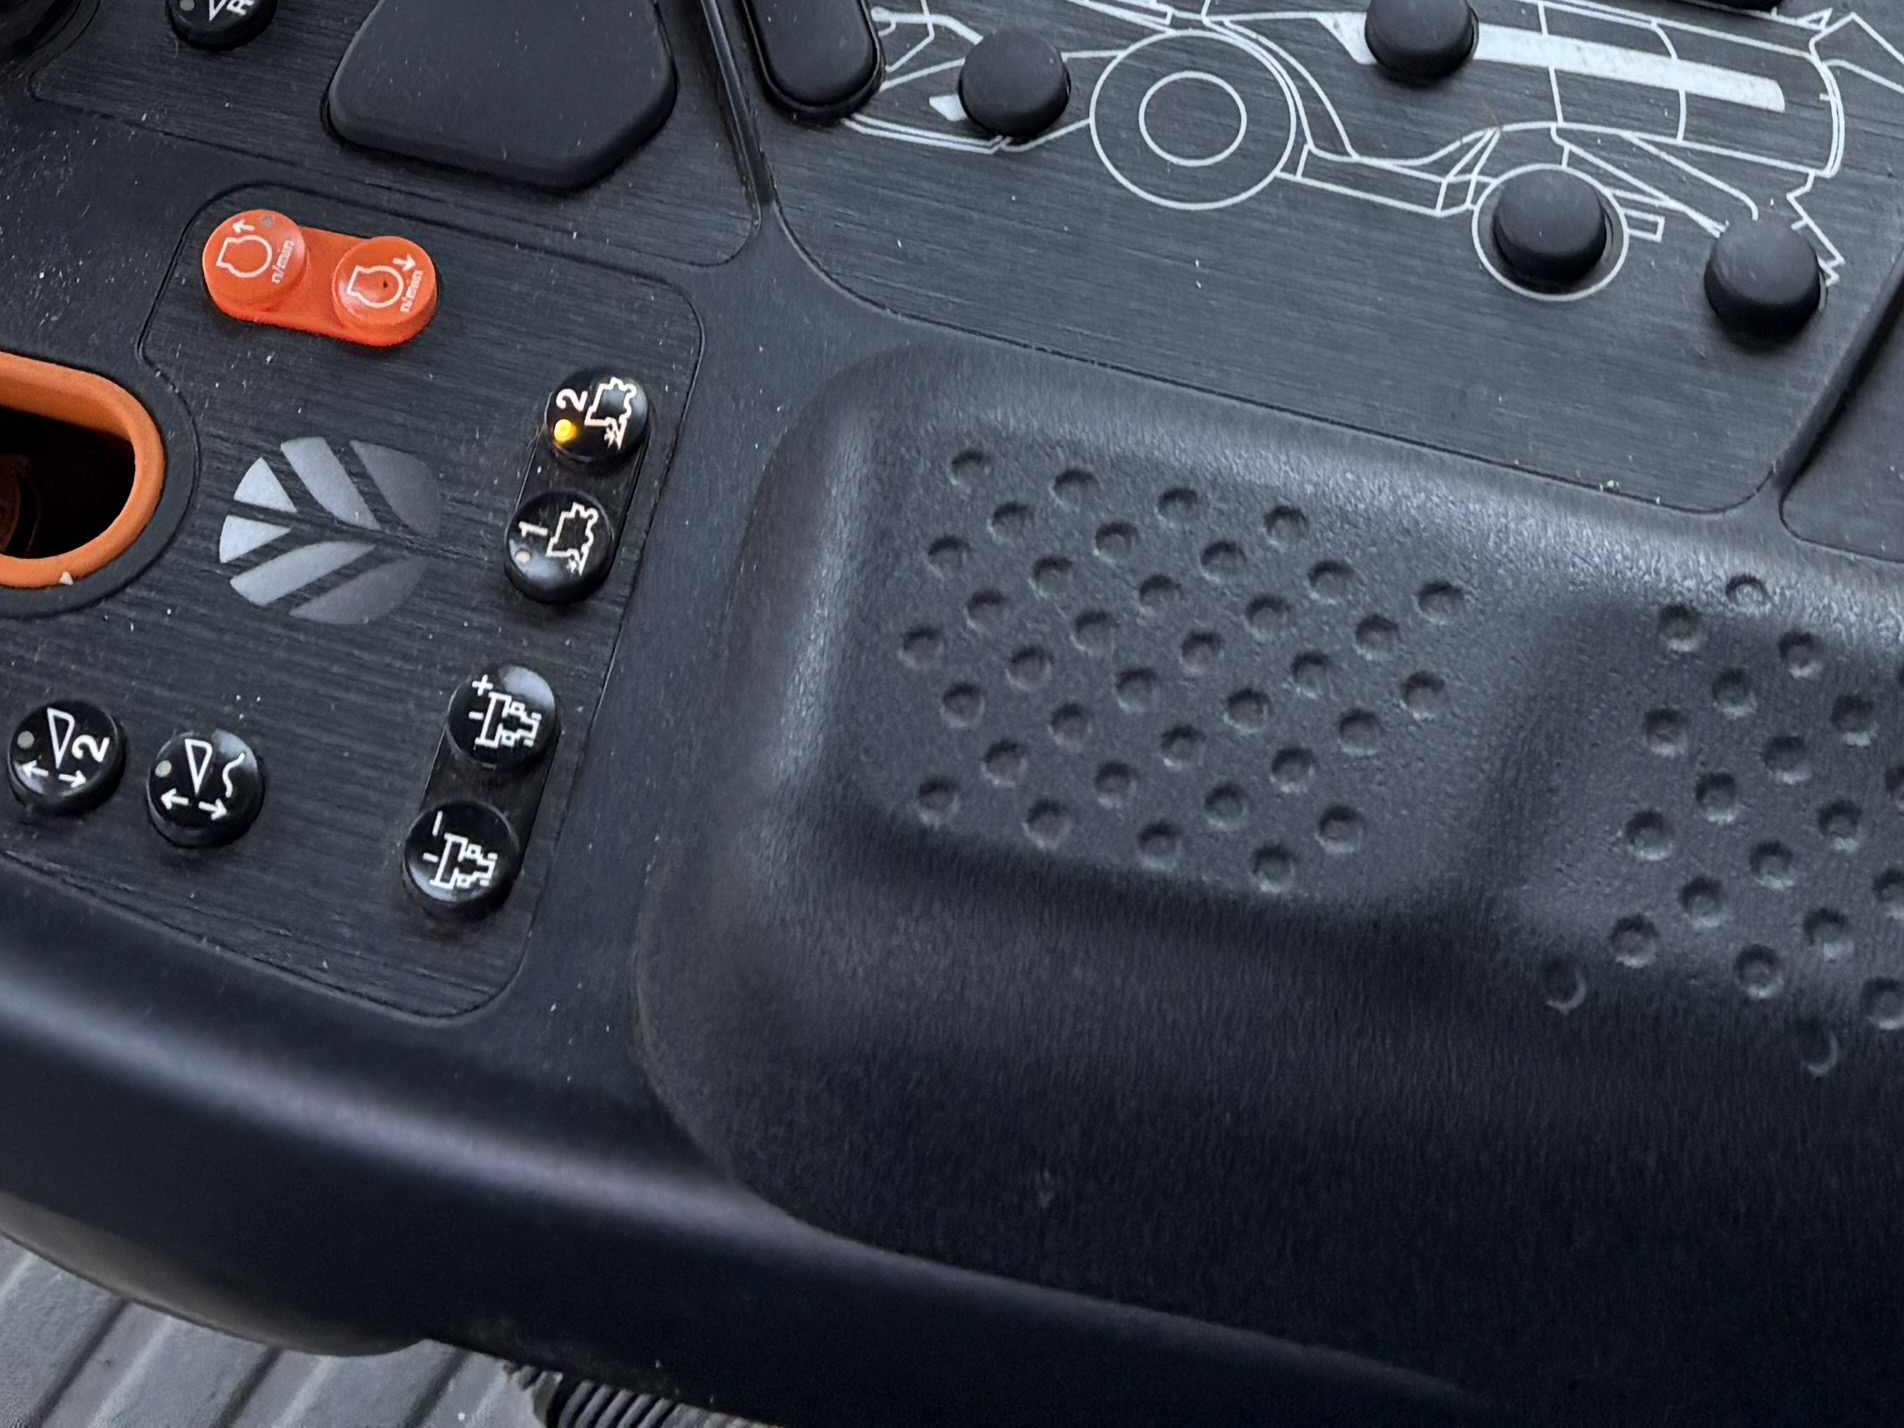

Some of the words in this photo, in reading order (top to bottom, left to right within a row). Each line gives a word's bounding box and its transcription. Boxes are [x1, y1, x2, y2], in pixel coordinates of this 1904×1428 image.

[555, 387, 589, 411] 2
[518, 520, 549, 540] 1
[71, 733, 111, 763] 2
